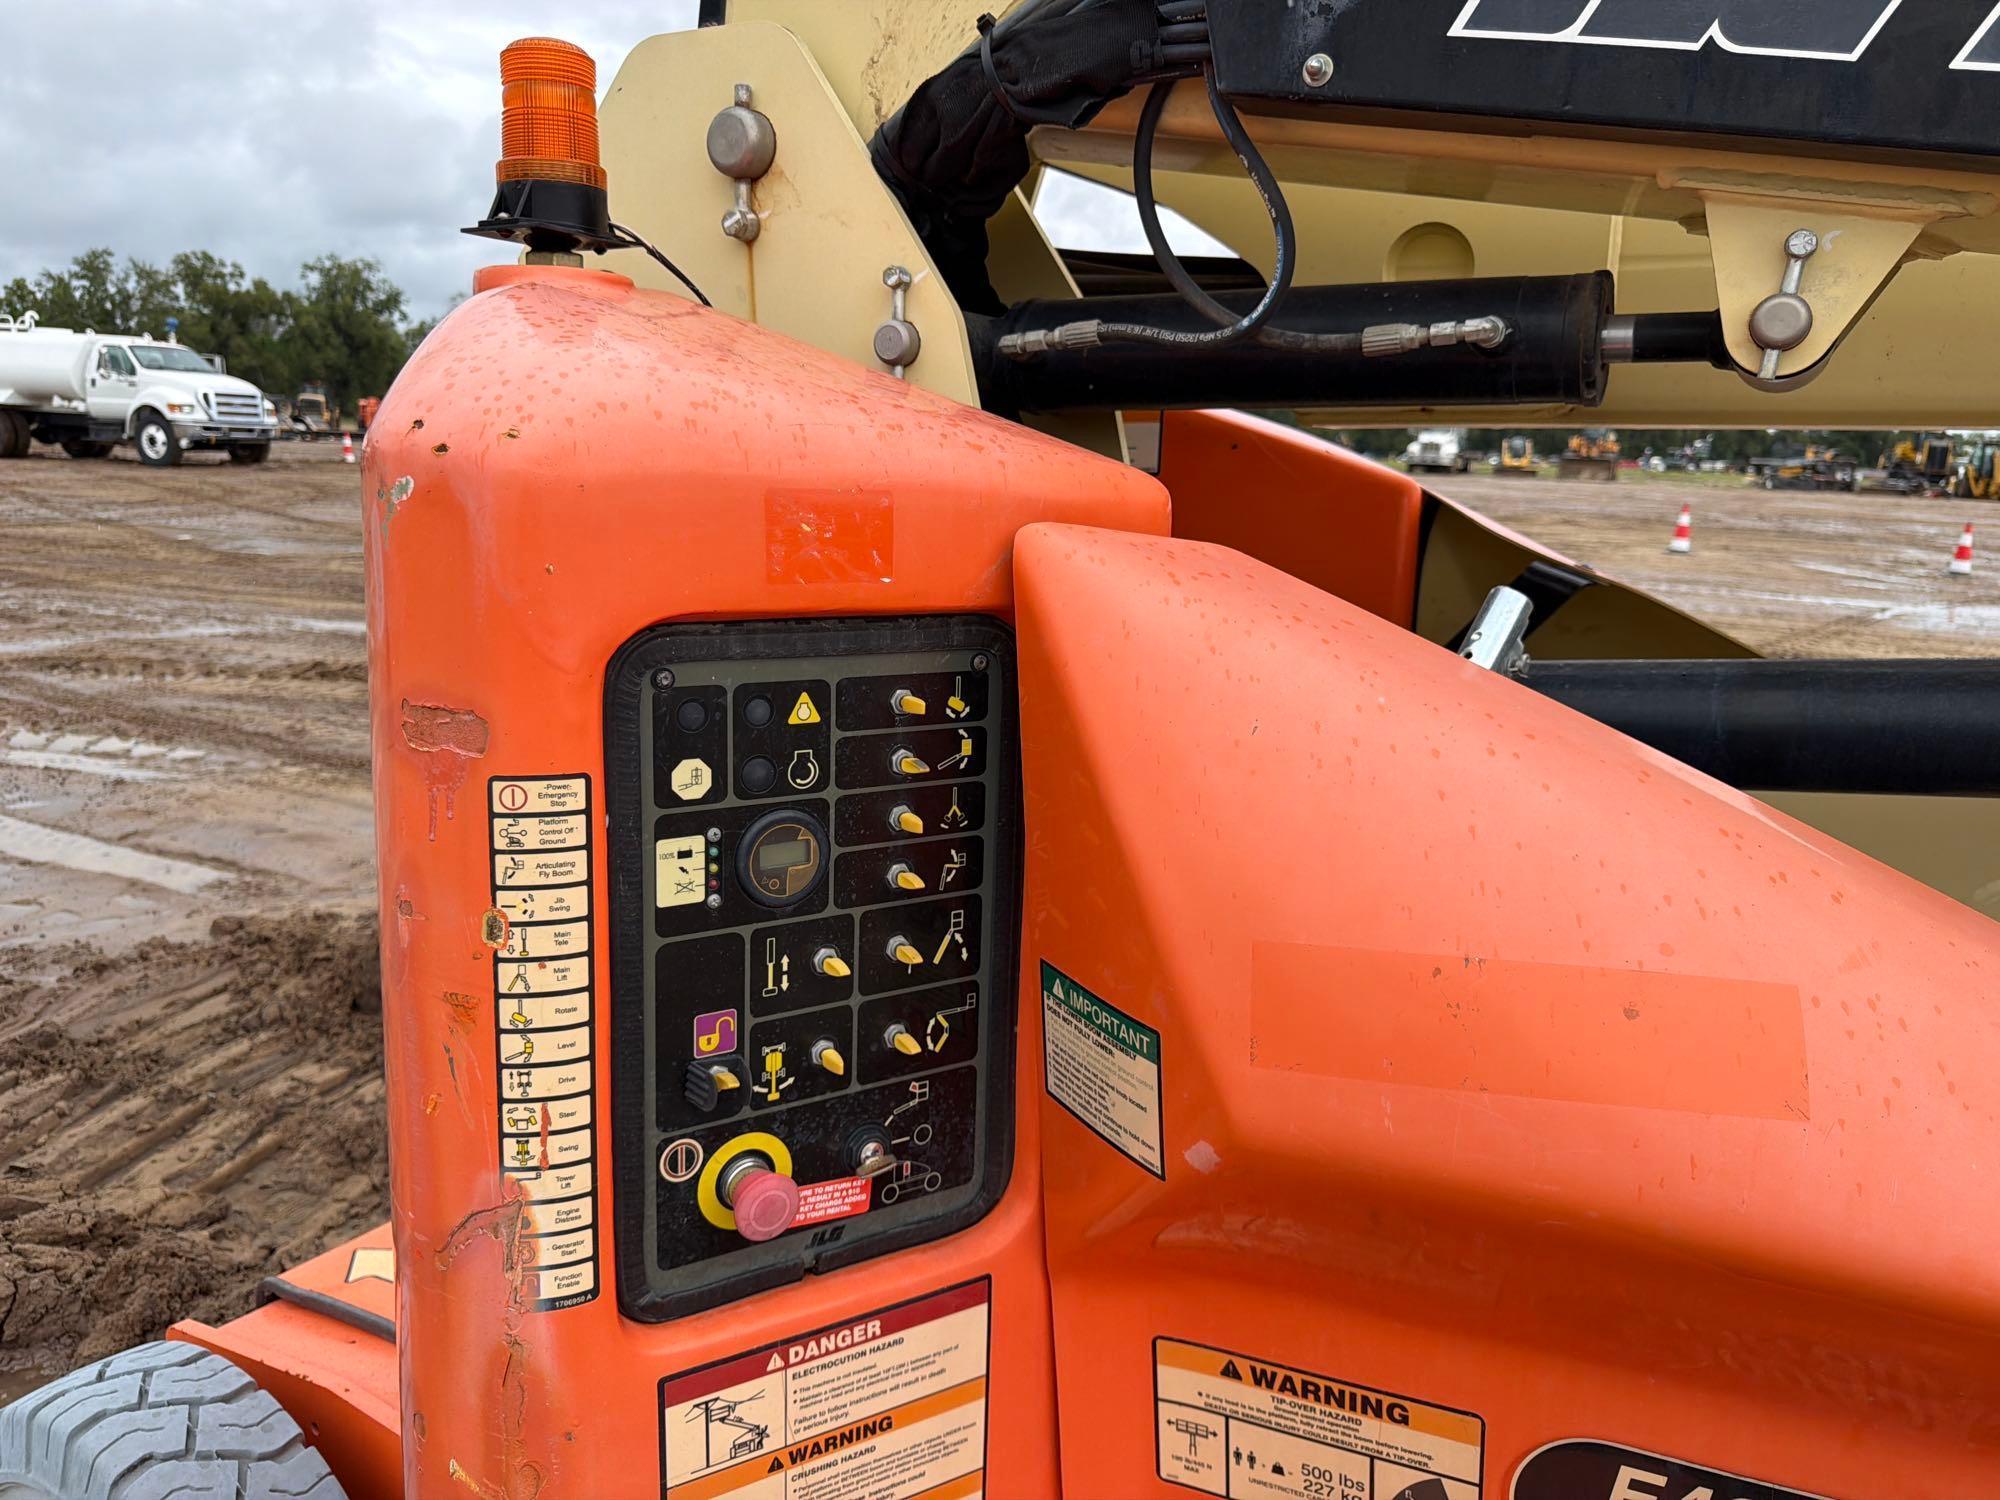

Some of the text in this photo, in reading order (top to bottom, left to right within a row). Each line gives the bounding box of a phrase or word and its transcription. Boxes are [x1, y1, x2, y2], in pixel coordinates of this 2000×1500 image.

[538, 791, 578, 800] Emergency
[550, 799, 567, 808] Stop
[538, 818, 569, 826] Platform
[540, 826, 574, 836] Control Off
[539, 837, 566, 846] Ground
[536, 860, 576, 870] Articulating
[538, 868, 573, 879] Fly Boom
[554, 897, 566, 905] Jib
[549, 904, 570, 913] Swing
[554, 938, 569, 946] Tele
[554, 966, 570, 974] Main
[556, 973, 568, 982] Lift
[555, 1006, 578, 1014] Rotate
[1069, 989, 1150, 1054] IMPORTANT
[1062, 1014, 1072, 1028] NOT
[1074, 1023, 1090, 1041] FULLY
[1091, 1036, 1114, 1059] LOWER:
[1063, 1005, 1082, 1025] LOWER
[1083, 1019, 1100, 1038] BOOM
[1103, 1033, 1136, 1062] ASSEMBLY
[558, 1041, 576, 1049] Level
[558, 1075, 576, 1084] Drive
[558, 1110, 577, 1118] Steer
[558, 1143, 579, 1153] Swing
[556, 1174, 576, 1183] Tower
[560, 1181, 572, 1189] Lift
[814, 1186, 823, 1194] TO
[824, 1181, 851, 1192] RETURN
[852, 1179, 865, 1187] KEY
[799, 1203, 813, 1212] KEY
[815, 1197, 842, 1209] CHARGE
[843, 1193, 866, 1203] ADDED
[806, 1192, 831, 1203] RESULT
[556, 1206, 580, 1218] Engine
[806, 1209, 824, 1219] YOUR
[826, 1203, 851, 1215] RENTAL
[555, 1214, 582, 1224] Distress
[804, 1225, 846, 1250] JLG
[552, 1239, 585, 1252] Generator
[561, 1246, 578, 1256] Start
[554, 1272, 582, 1282] Function
[558, 1280, 580, 1290] Enable
[788, 1319, 882, 1365] DANGER
[792, 1348, 867, 1381] ELECTROCUTION
[869, 1336, 903, 1354] HAZARD
[1249, 1365, 1411, 1427] WARNING
[794, 1411, 816, 1426] Failure
[818, 1408, 826, 1417] to
[827, 1401, 847, 1414] follow
[849, 1387, 887, 1406] instructions
[1270, 1394, 1362, 1426] TIP-OVER HAZARD
[1273, 1404, 1298, 1416] Ground
[1326, 1419, 1359, 1434] operation
[789, 1413, 892, 1466] WARNING
[1241, 1411, 1272, 1425] SERIOUS
[1274, 1420, 1299, 1432] INJURY
[1302, 1428, 1328, 1440] COULD
[1330, 1436, 1358, 1449] RESULT
[1360, 1444, 1383, 1456] FROM
[1392, 1453, 1431, 1469] TIP-OVER.
[791, 1458, 838, 1482] CRUSHING
[841, 1444, 876, 1463] HAZARD
[1301, 1463, 1366, 1492] 500 lbs
[1248, 1476, 1305, 1498] UNRESTRICTED
[1302, 1478, 1335, 1498] 227
